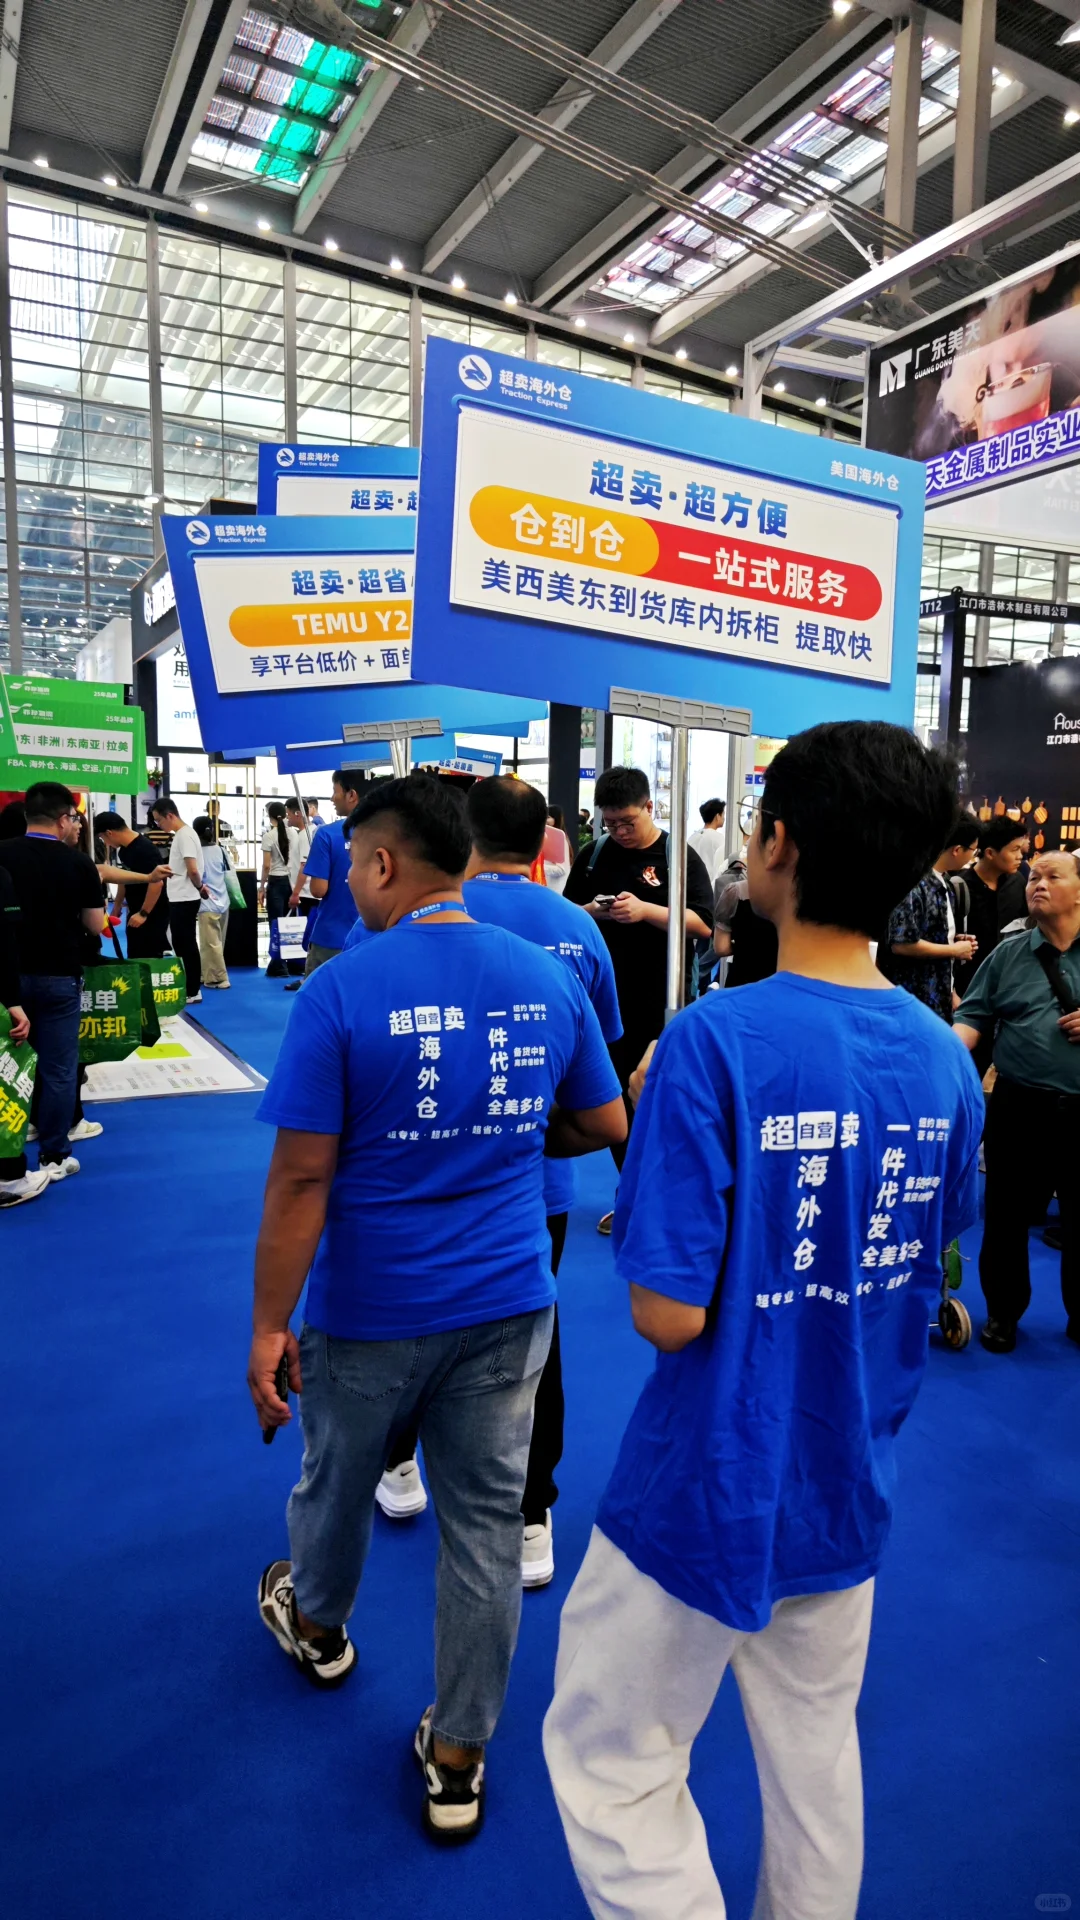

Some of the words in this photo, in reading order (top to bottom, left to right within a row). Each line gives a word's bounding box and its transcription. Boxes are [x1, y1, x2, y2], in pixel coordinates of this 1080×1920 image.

[915, 318, 981, 370] 广东美天
[879, 348, 912, 398] MT
[914, 366, 935, 380] GUANG
[935, 357, 953, 372] DONG
[499, 369, 572, 402] 超卖海外仓
[500, 386, 533, 402] Traction
[536, 396, 568, 410] Express
[298, 452, 340, 462] 超卖海外仓
[830, 460, 899, 492] 美国海外仓
[589, 459, 788, 539] 超卖·超方便
[214, 525, 267, 537] 超卖海外仓
[509, 502, 625, 562] 仓到仓
[292, 567, 413, 596] 超卖·超省
[678, 547, 849, 608] 一站式服务
[292, 611, 368, 636] TEMU
[375, 610, 409, 632] Y2
[480, 557, 780, 646] 美西美东到货库内拆柜
[795, 620, 873, 663] 提取快
[959, 597, 1068, 617] 江门市浩林木制品有限公司
[250, 650, 357, 677] 享平台低价
[105, 715, 134, 724] 25年品牌
[16, 734, 31, 745] 东
[37, 735, 61, 747] 非洲
[66, 737, 100, 750] 东南亚
[106, 741, 129, 753] 拉美
[487, 1010, 509, 1096] 一件代发
[416, 1036, 441, 1118] 海外仓
[487, 1096, 544, 1116] 全美多仓
[866, 1124, 911, 1240] 一件代发
[793, 1155, 829, 1271] 海外仓
